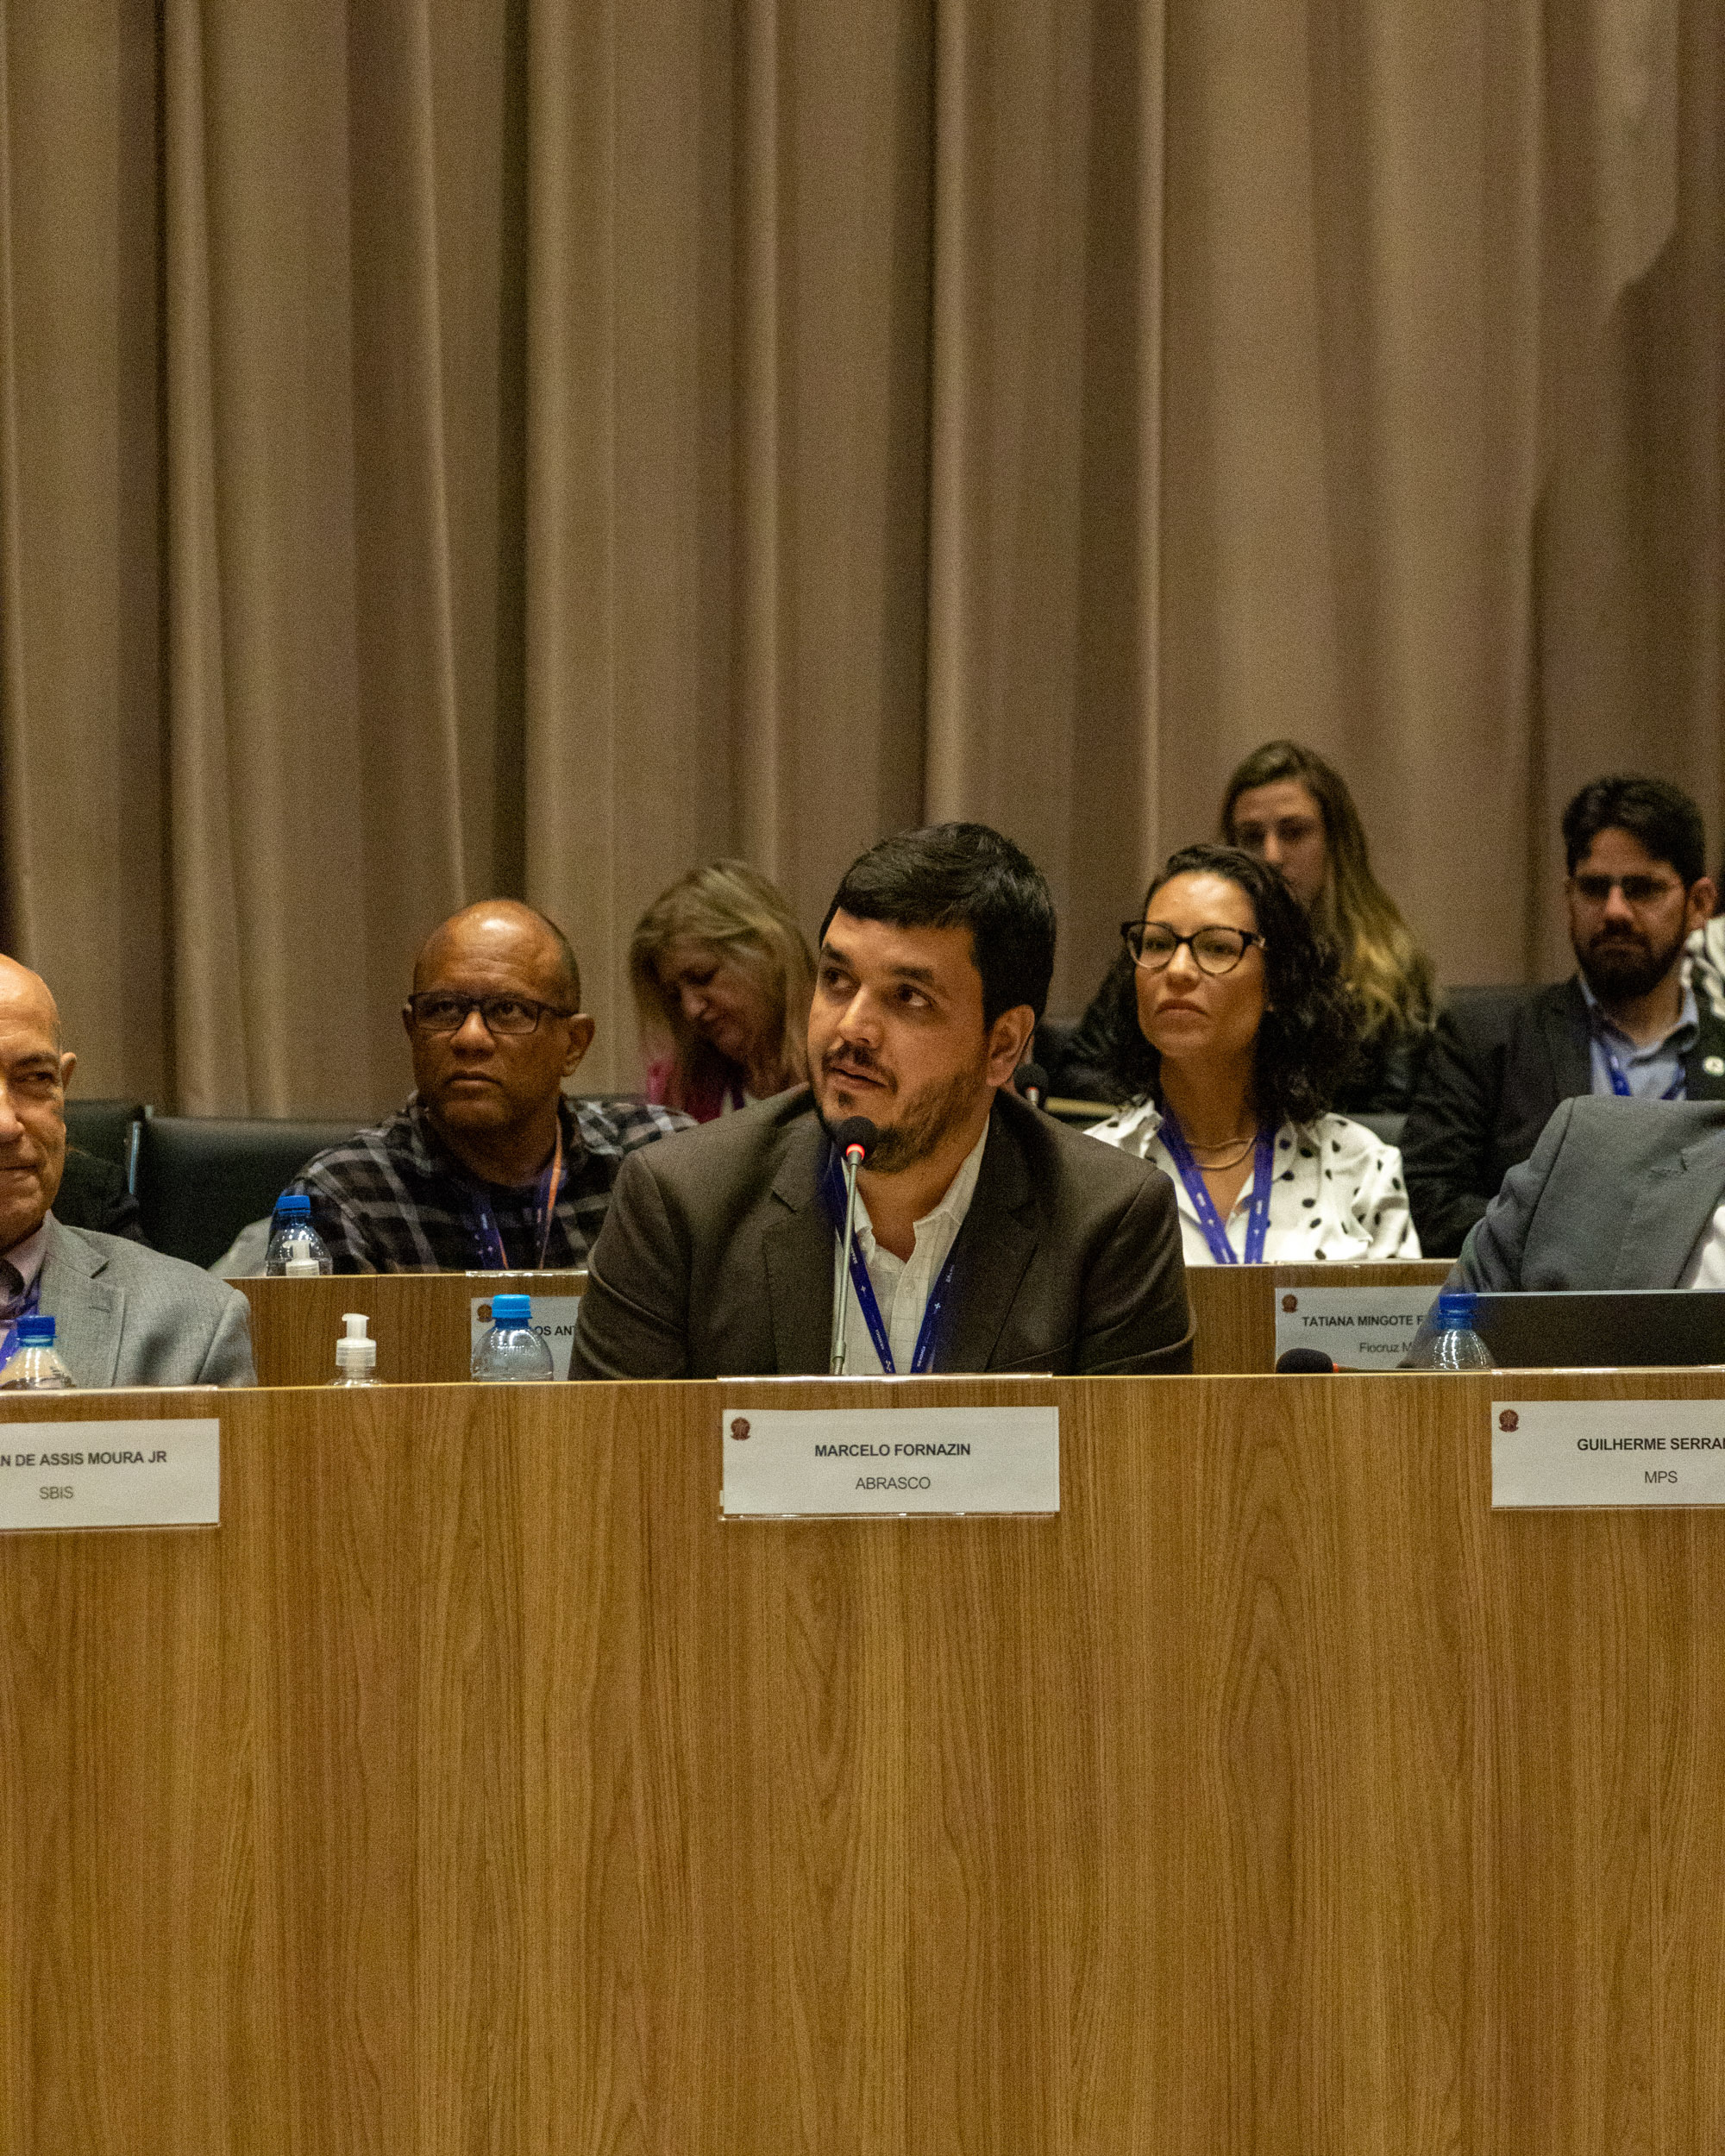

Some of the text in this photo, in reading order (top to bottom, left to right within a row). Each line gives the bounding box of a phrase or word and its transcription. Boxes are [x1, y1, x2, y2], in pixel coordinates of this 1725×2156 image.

[1302, 1316, 1354, 1326] TATIANA
[1358, 1315, 1413, 1326] MINGOTE
[1359, 1342, 1399, 1353] Fiocruz
[814, 1443, 971, 1457] MARCELO FORNAZIN
[1577, 1437, 1725, 1451] GUILHERME SERRA
[0, 1451, 166, 1467] N DE ASSIS MOURA JR
[855, 1476, 932, 1490] ABRASCO
[1644, 1470, 1678, 1484] MPS
[39, 1486, 74, 1500] SBIS
